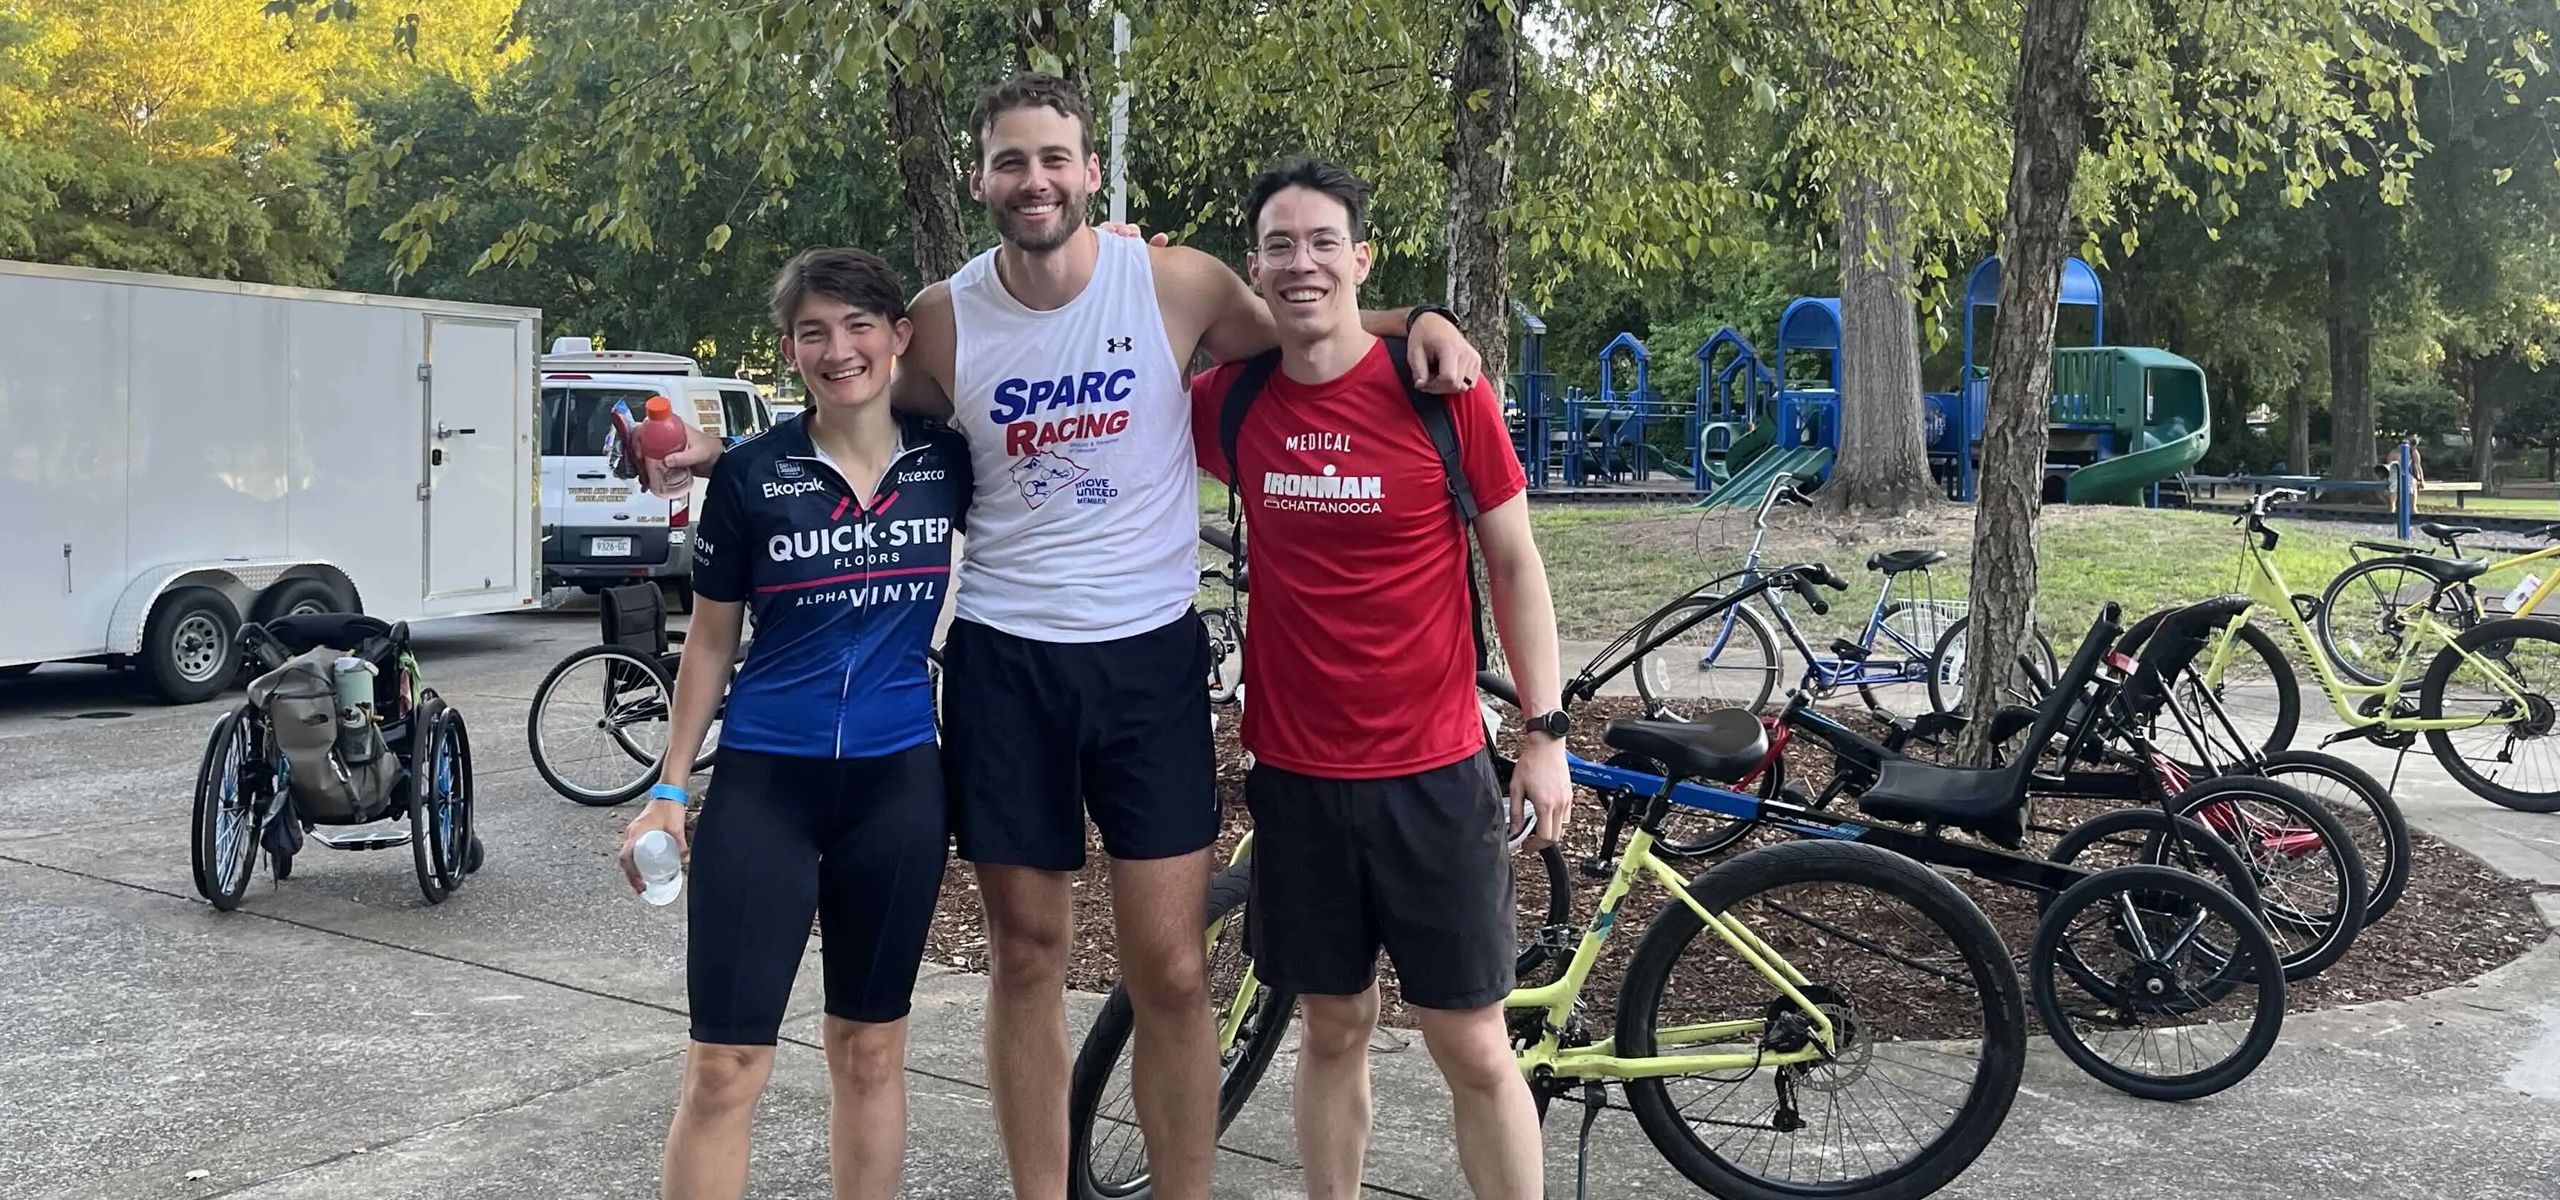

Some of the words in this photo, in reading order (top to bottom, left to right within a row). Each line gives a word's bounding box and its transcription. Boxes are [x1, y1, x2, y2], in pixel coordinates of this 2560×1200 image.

[990, 369, 1136, 425] SPARC
[1006, 410, 1130, 457] RACING
[1286, 432, 1351, 453] MEDICAL
[762, 477, 825, 498] Ekopak
[1263, 464, 1382, 499] IRONMAN
[1281, 499, 1382, 514] CHATTANOOGA
[834, 552, 900, 569] FLOORS
[796, 590, 847, 607] ALPHA
[849, 581, 934, 607] VINYL
